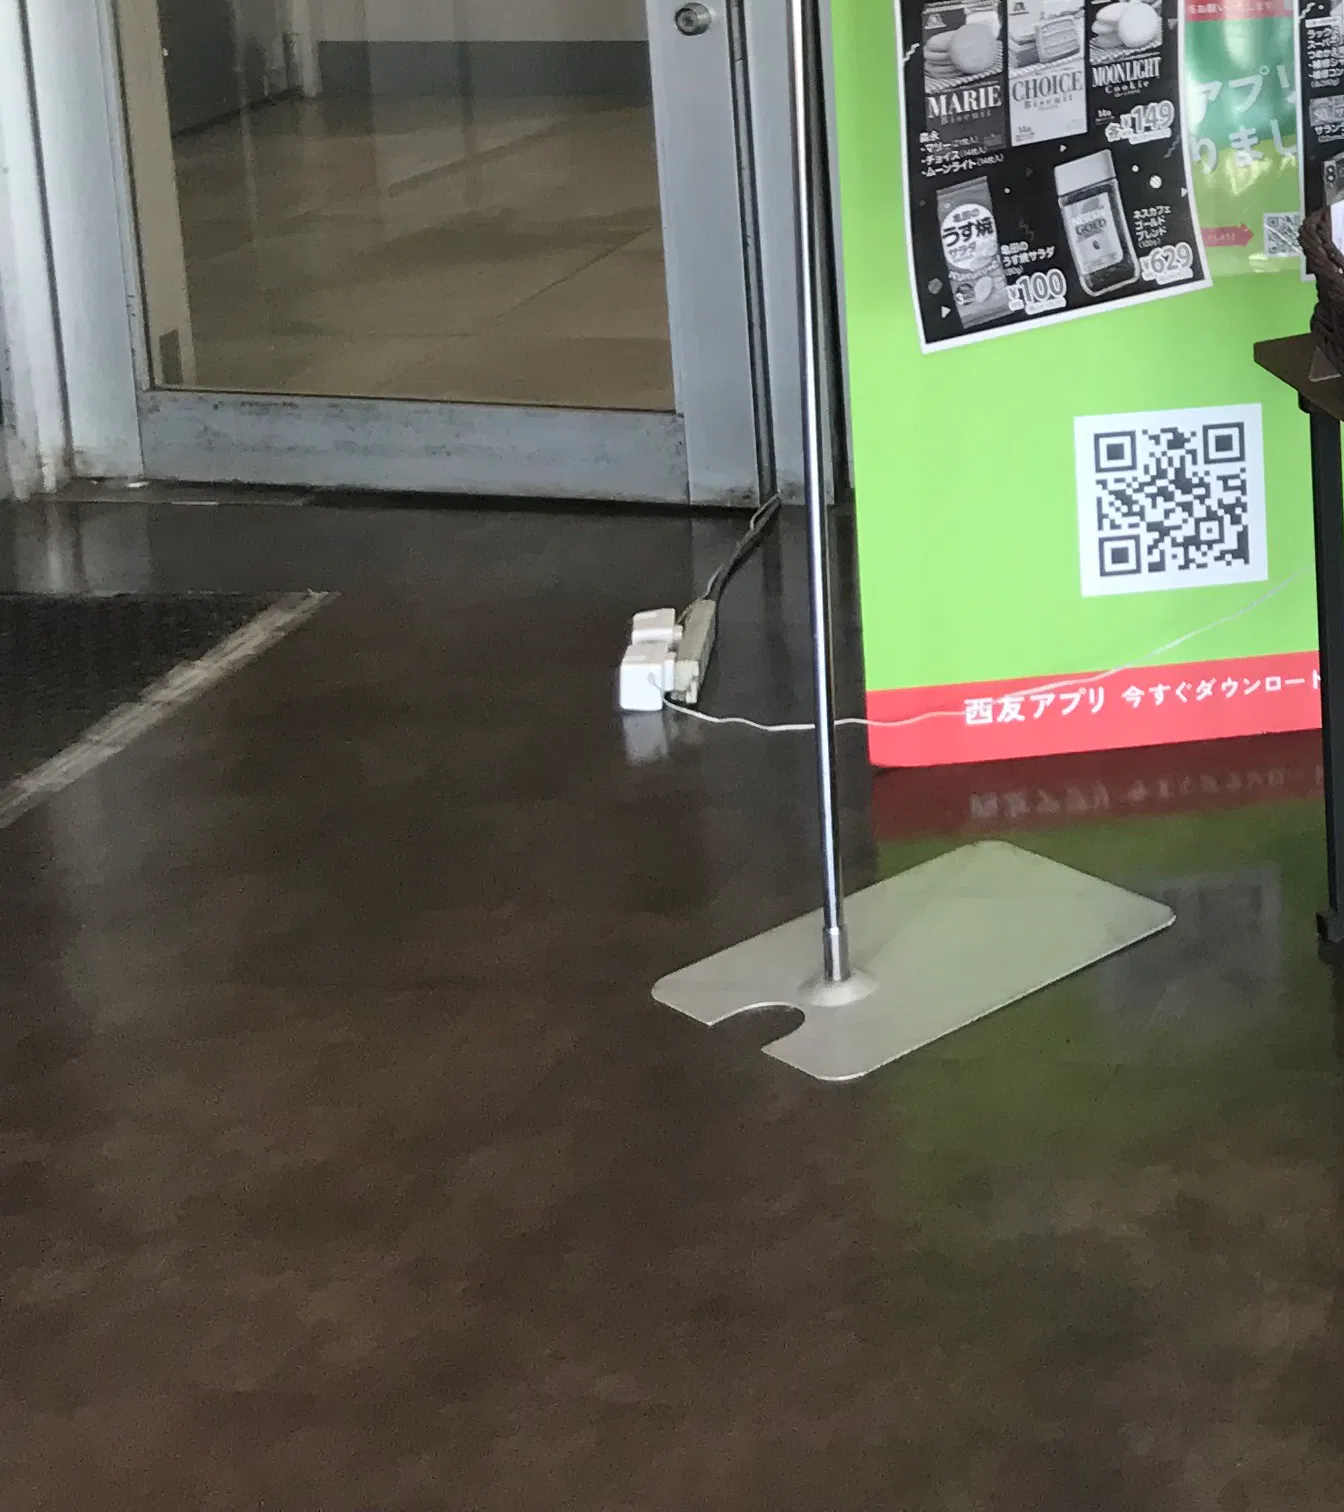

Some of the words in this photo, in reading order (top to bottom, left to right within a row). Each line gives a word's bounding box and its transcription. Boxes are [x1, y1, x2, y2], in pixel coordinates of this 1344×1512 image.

[1011, 71, 1084, 102] CHOICE
[1092, 57, 1161, 88] MOONLIGHT
[928, 86, 1002, 117] MARIE
[963, 685, 1106, 726] 西友アプリ
